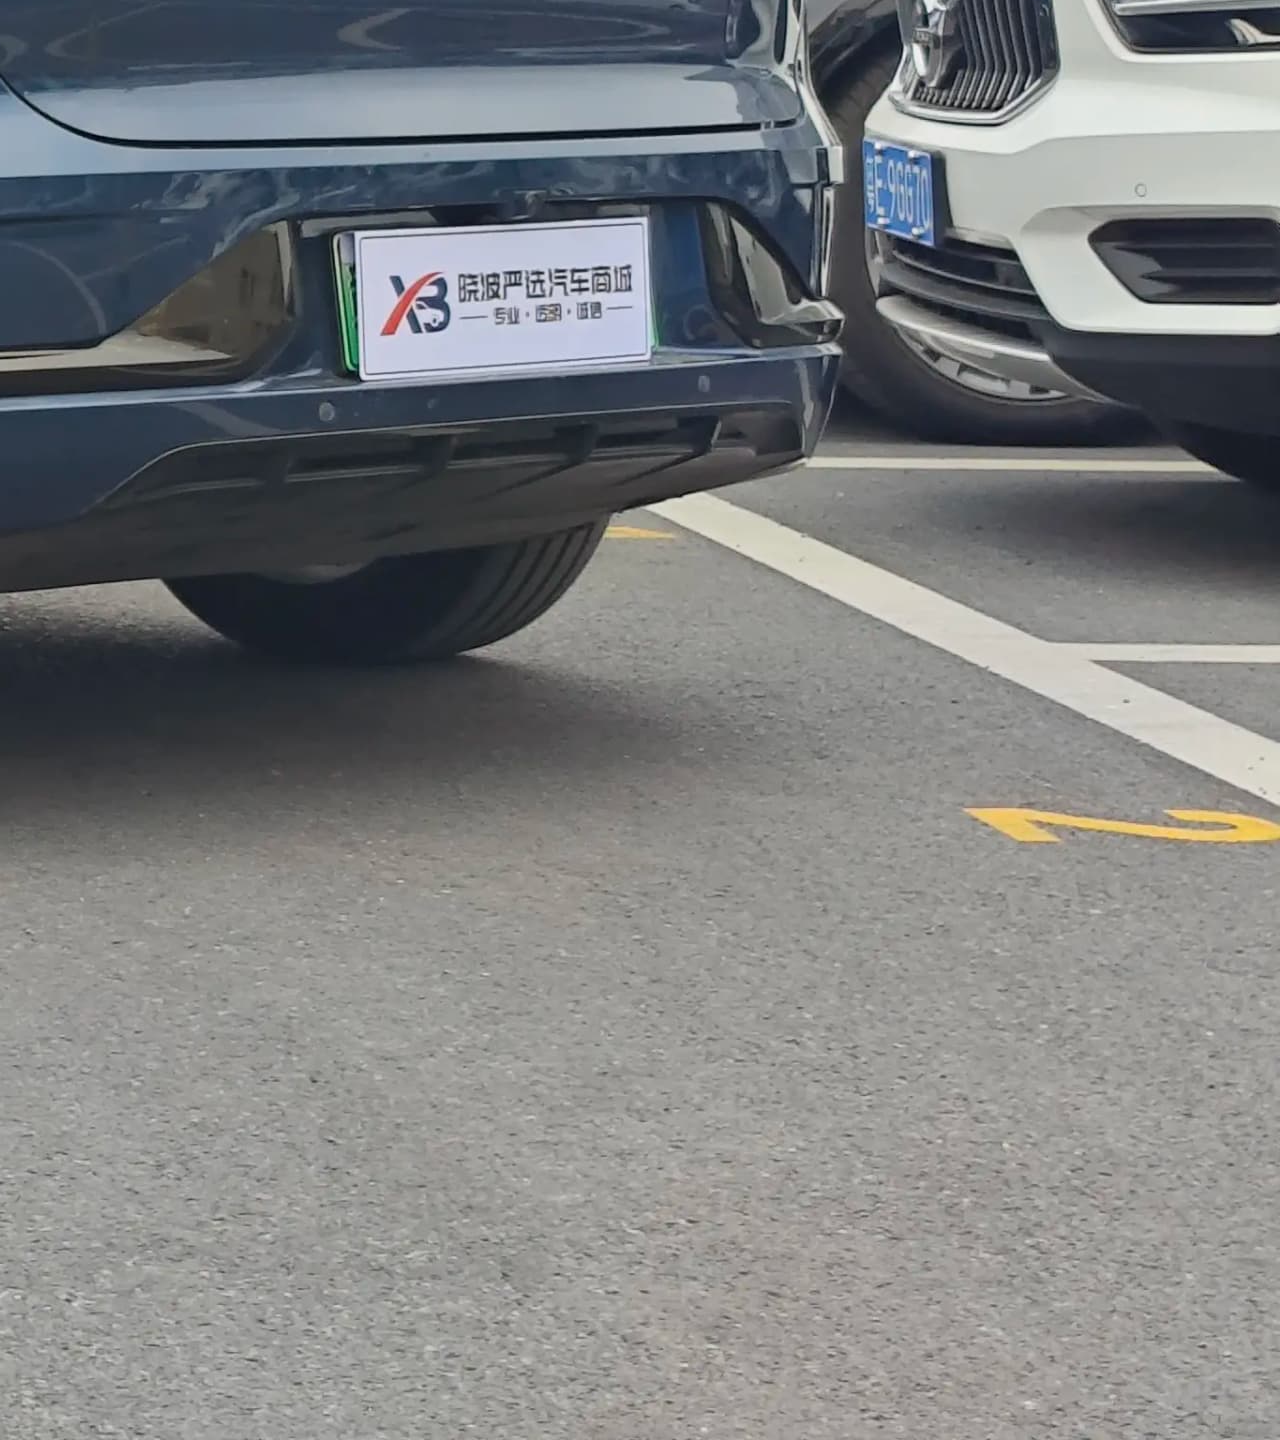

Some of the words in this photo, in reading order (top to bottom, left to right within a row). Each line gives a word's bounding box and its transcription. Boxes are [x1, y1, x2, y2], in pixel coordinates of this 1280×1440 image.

[458, 264, 633, 303] 晓波严选汽车商城
